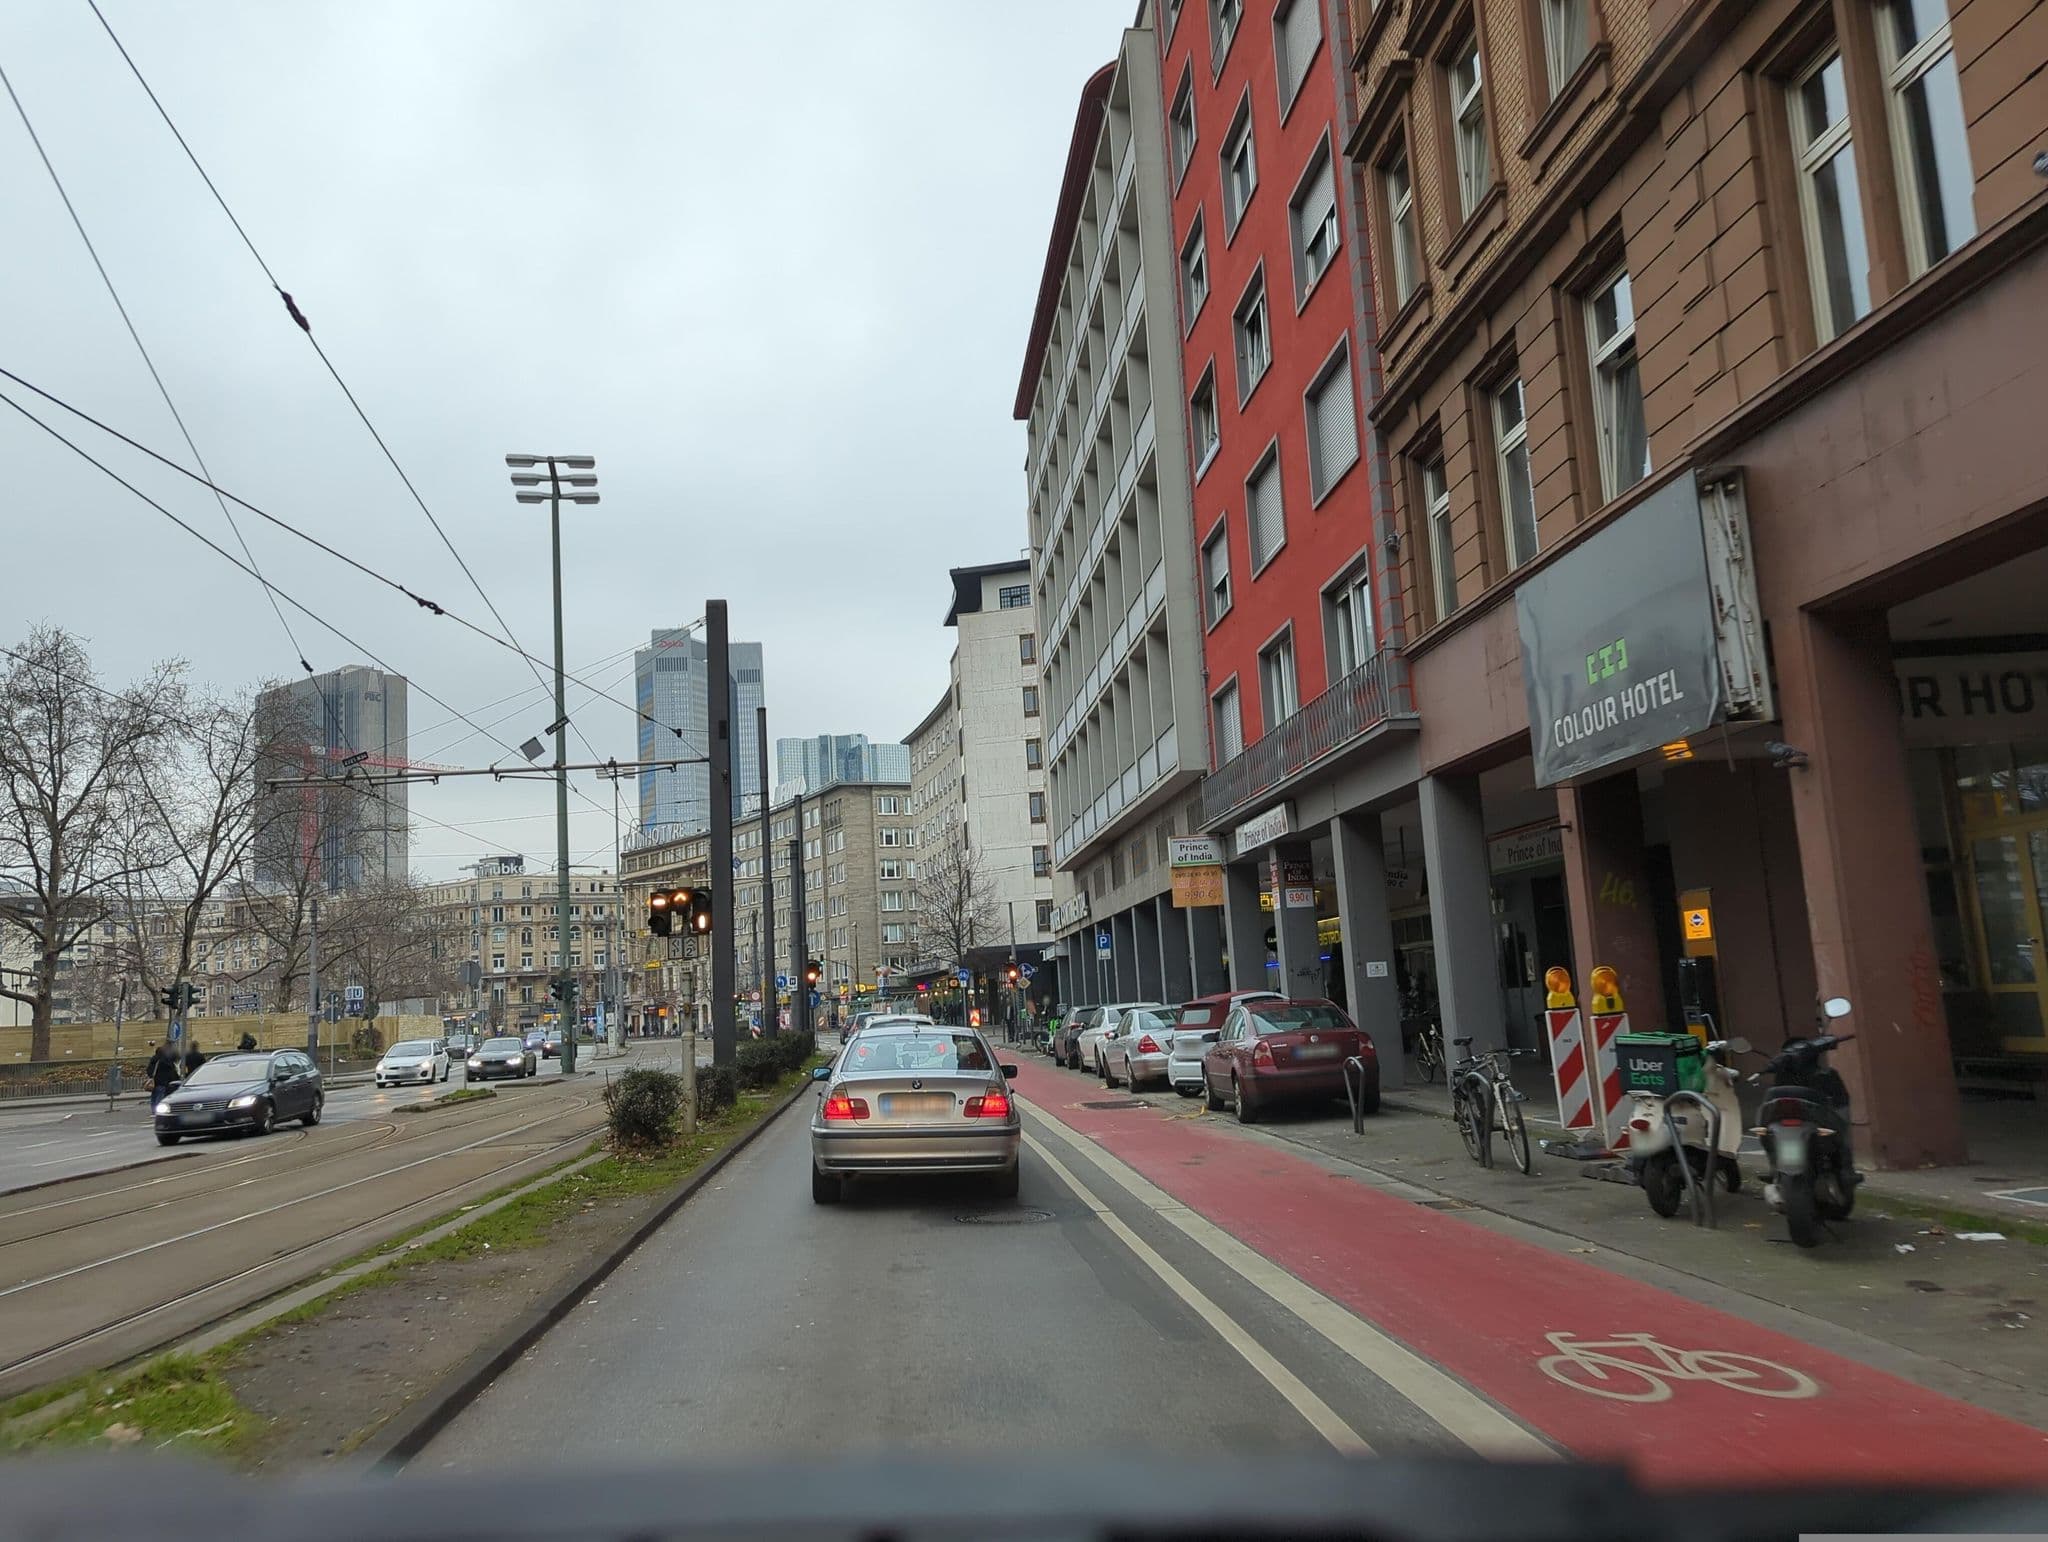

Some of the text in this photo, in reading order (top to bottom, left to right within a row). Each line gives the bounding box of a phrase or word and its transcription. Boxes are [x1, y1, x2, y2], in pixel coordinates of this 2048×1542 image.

[1554, 669, 1684, 748] COLOUR HOTEL
[1179, 842, 1209, 852] Prince
[1507, 844, 1534, 864] Prince
[1536, 837, 1546, 857] of
[1178, 852, 1213, 863] of India
[1100, 936, 1107, 948] P
[686, 948, 693, 957] 2
[1629, 1058, 1664, 1071] Uber
[1630, 1072, 1665, 1085] Eats
